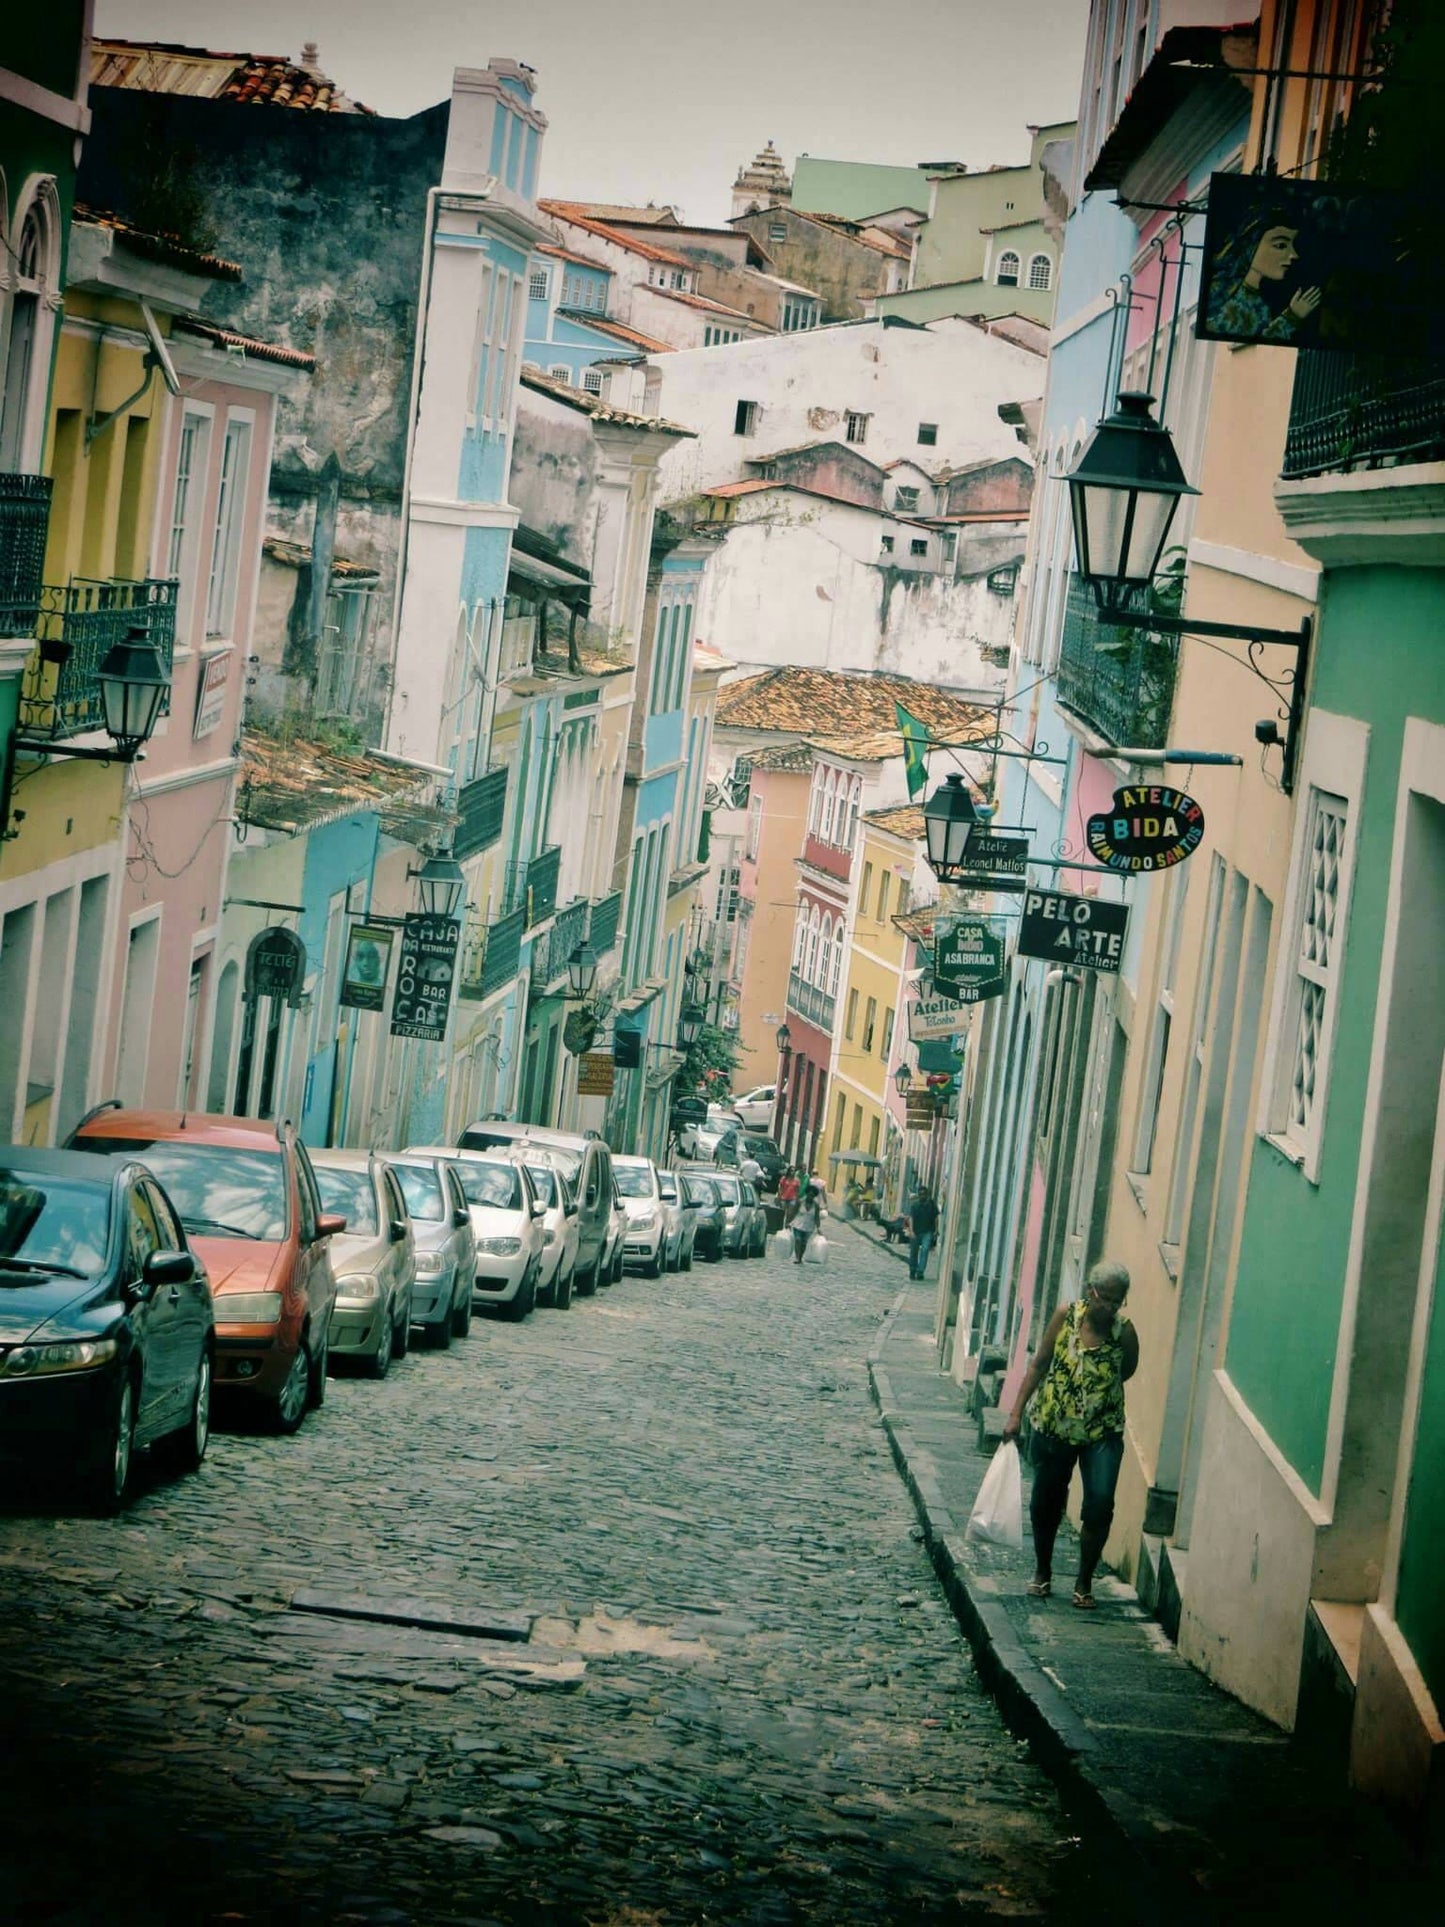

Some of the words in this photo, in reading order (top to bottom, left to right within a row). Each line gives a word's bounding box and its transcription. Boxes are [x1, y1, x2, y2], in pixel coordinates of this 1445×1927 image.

[1123, 786, 1201, 823] ATELIER
[1113, 816, 1179, 840] BIDA
[1090, 821, 1153, 870] RAIMUNDO
[1156, 826, 1202, 868] SANTOS
[963, 855, 993, 870] Leonel
[956, 927, 983, 939] CASA
[1053, 925, 1122, 957] ARTE
[403, 938, 419, 952] DA
[1073, 951, 1119, 970] Atelier
[422, 984, 446, 1000] BAR
[958, 987, 980, 1000] BAR
[914, 999, 963, 1016] Atelier
[395, 1023, 441, 1040] PIZZARIA
